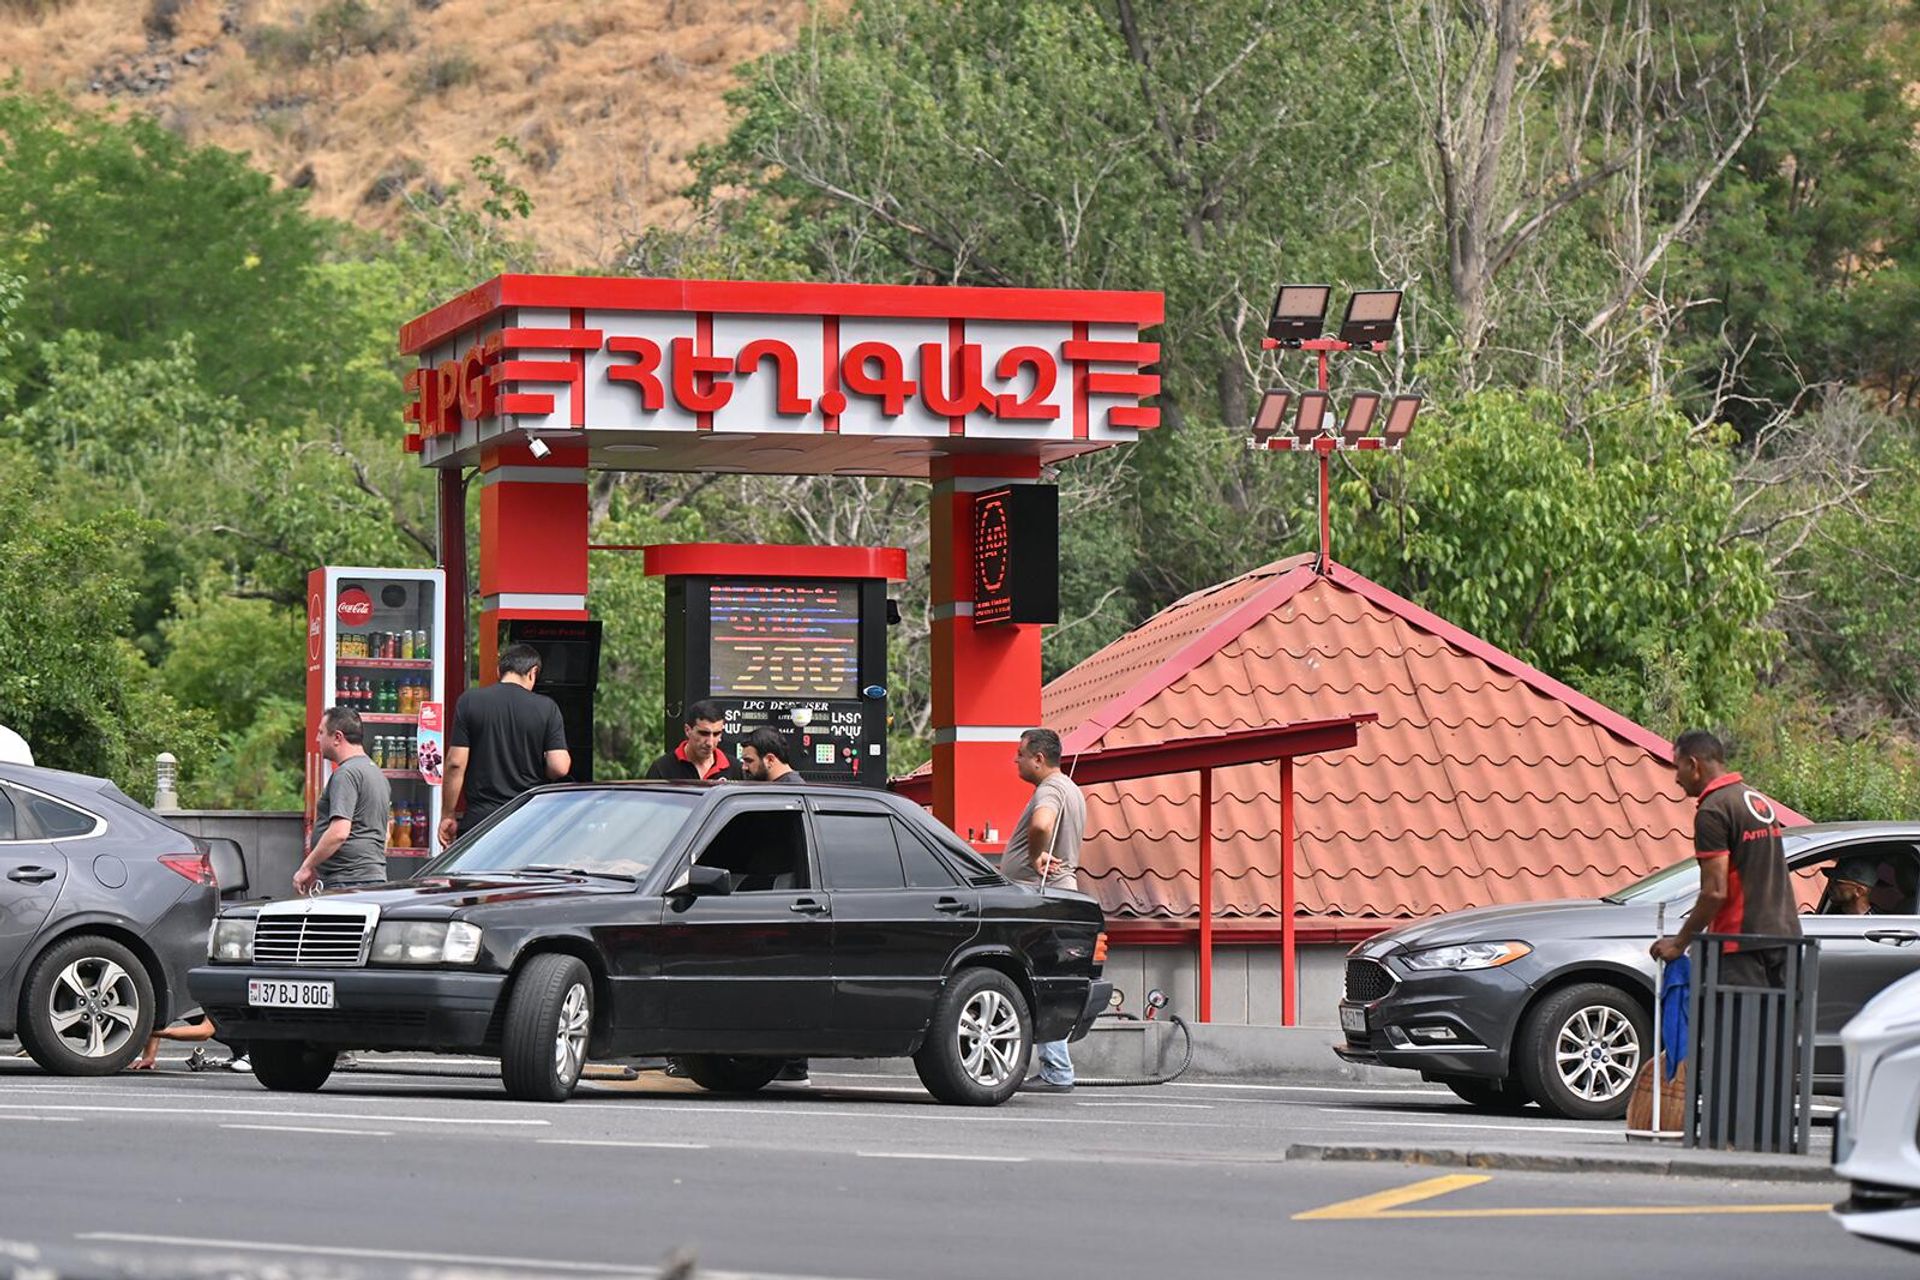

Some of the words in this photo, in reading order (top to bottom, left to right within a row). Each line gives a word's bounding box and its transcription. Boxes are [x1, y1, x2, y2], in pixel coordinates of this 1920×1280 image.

[418, 345, 490, 440] LPG
[607, 336, 1060, 419] ՀԵՂ.ԳԱԶ
[743, 701, 765, 710] LPG
[262, 983, 276, 1003] 37
[279, 984, 298, 1004] BJ
[302, 985, 328, 1005] 800
